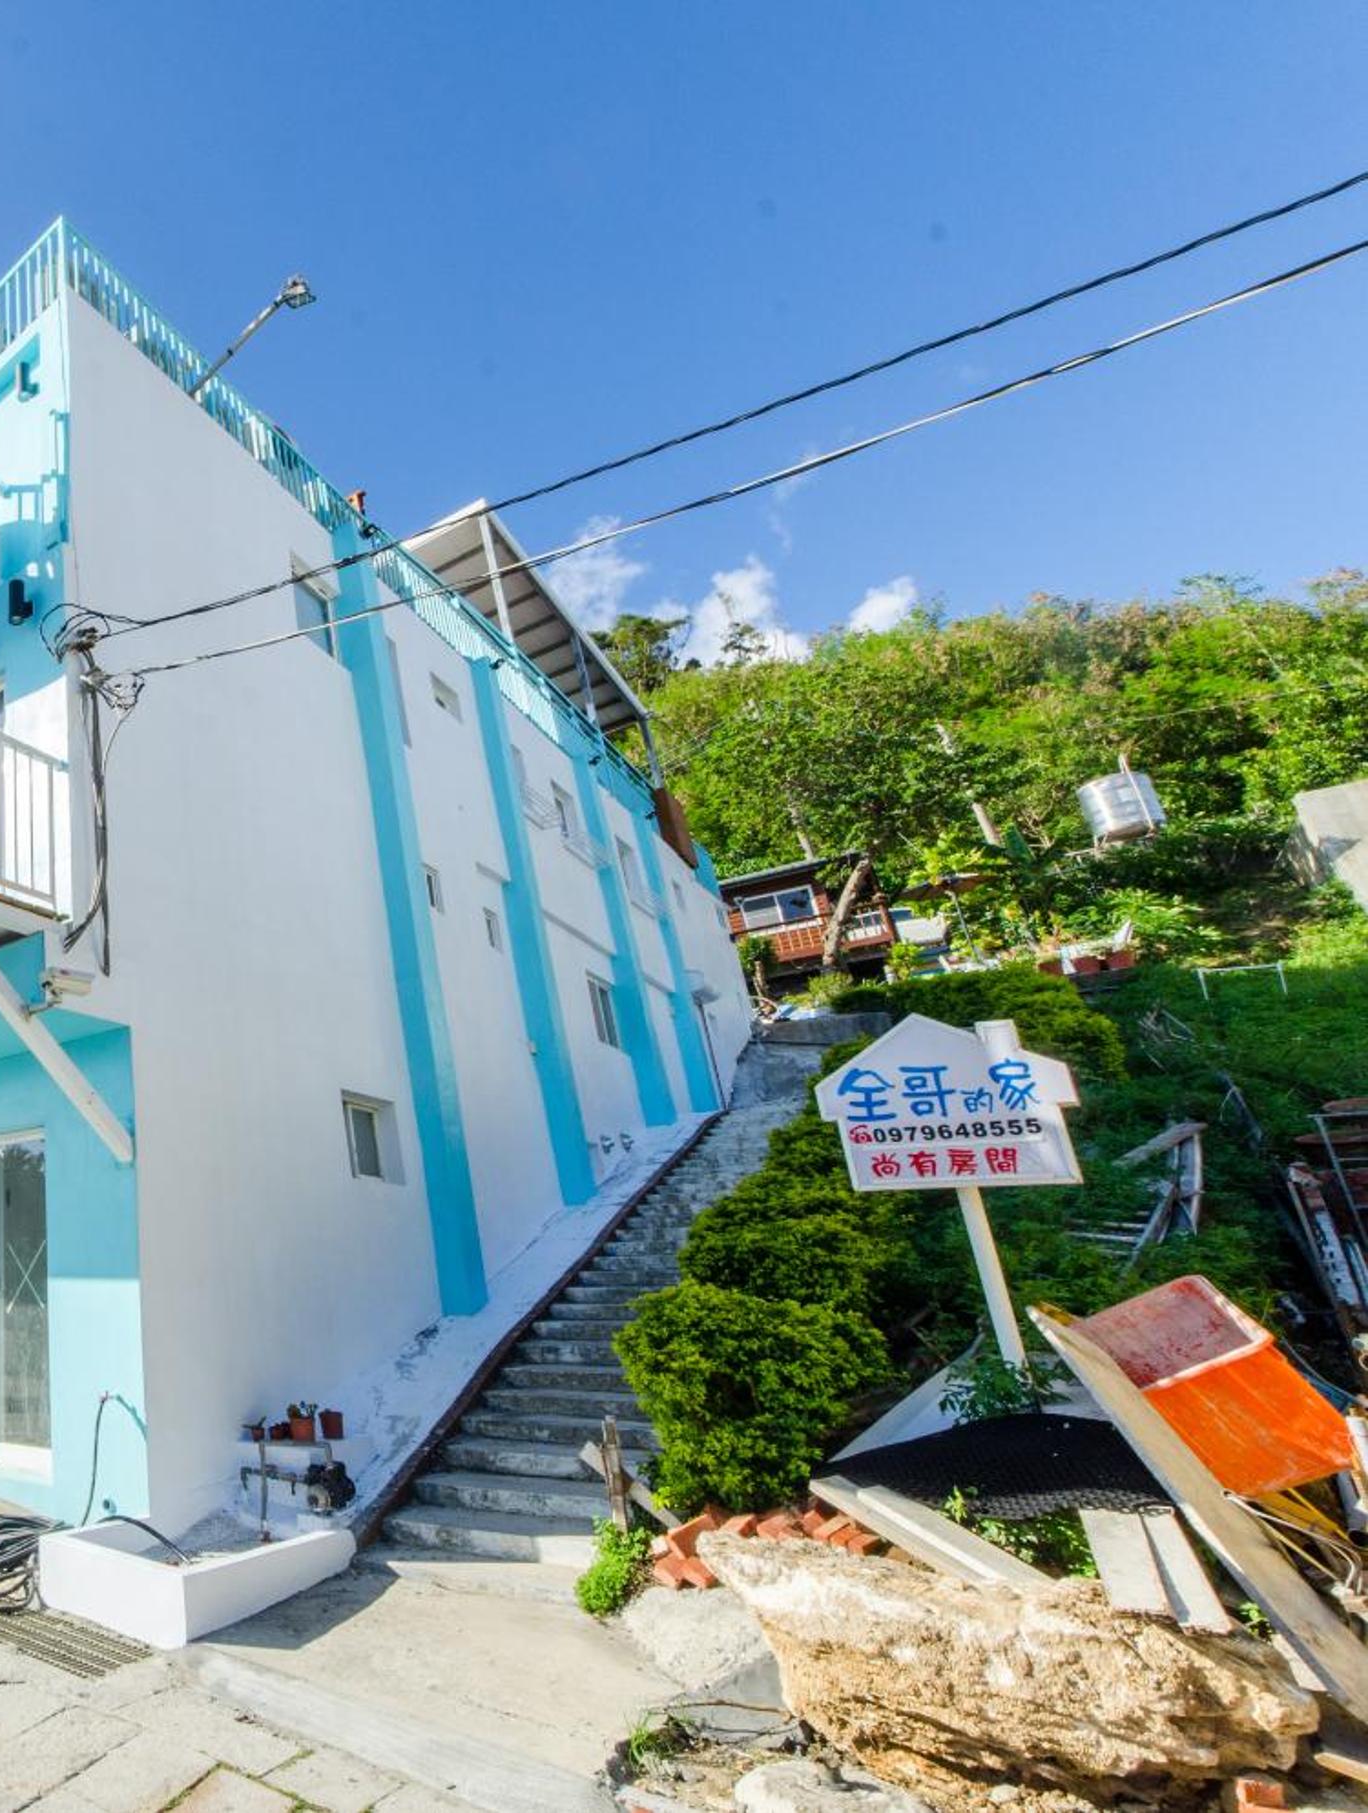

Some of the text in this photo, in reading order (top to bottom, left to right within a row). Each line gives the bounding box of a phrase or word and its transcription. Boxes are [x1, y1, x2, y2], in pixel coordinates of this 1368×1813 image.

[837, 1058, 1040, 1122] 全哥的家
[873, 1117, 1043, 1144] 0979648555
[871, 1147, 1019, 1178] 尚有房間
